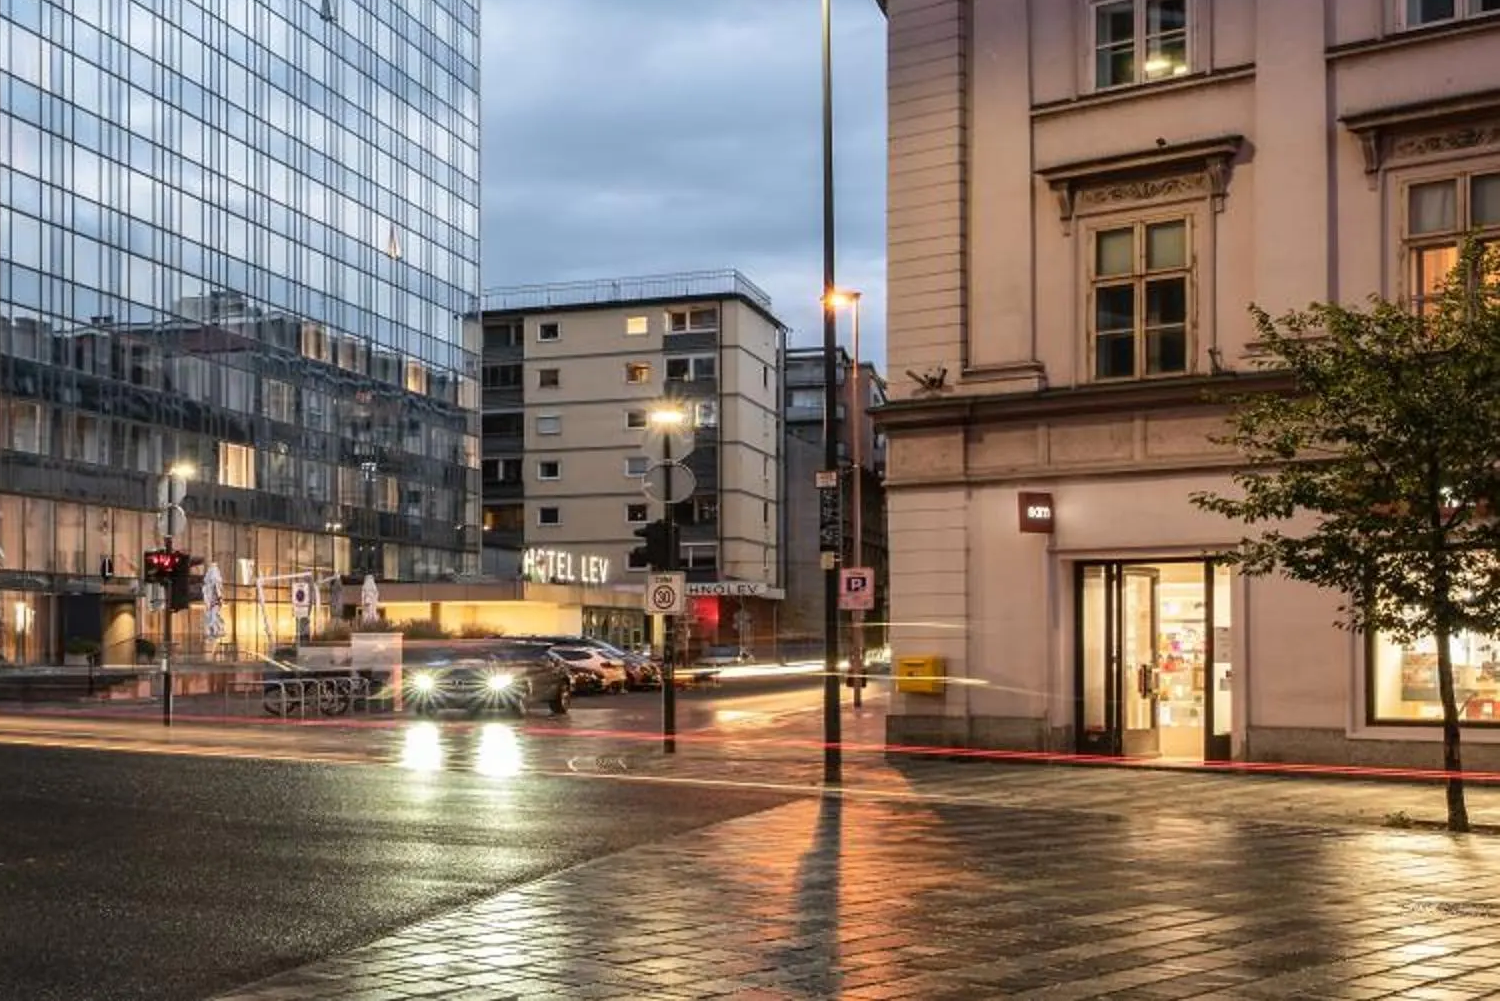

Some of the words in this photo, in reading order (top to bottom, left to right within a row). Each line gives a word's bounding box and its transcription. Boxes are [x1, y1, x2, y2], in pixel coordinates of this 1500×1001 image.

[581, 555, 609, 584] LEV
[851, 578, 863, 590] P
[657, 590, 671, 604] 30
